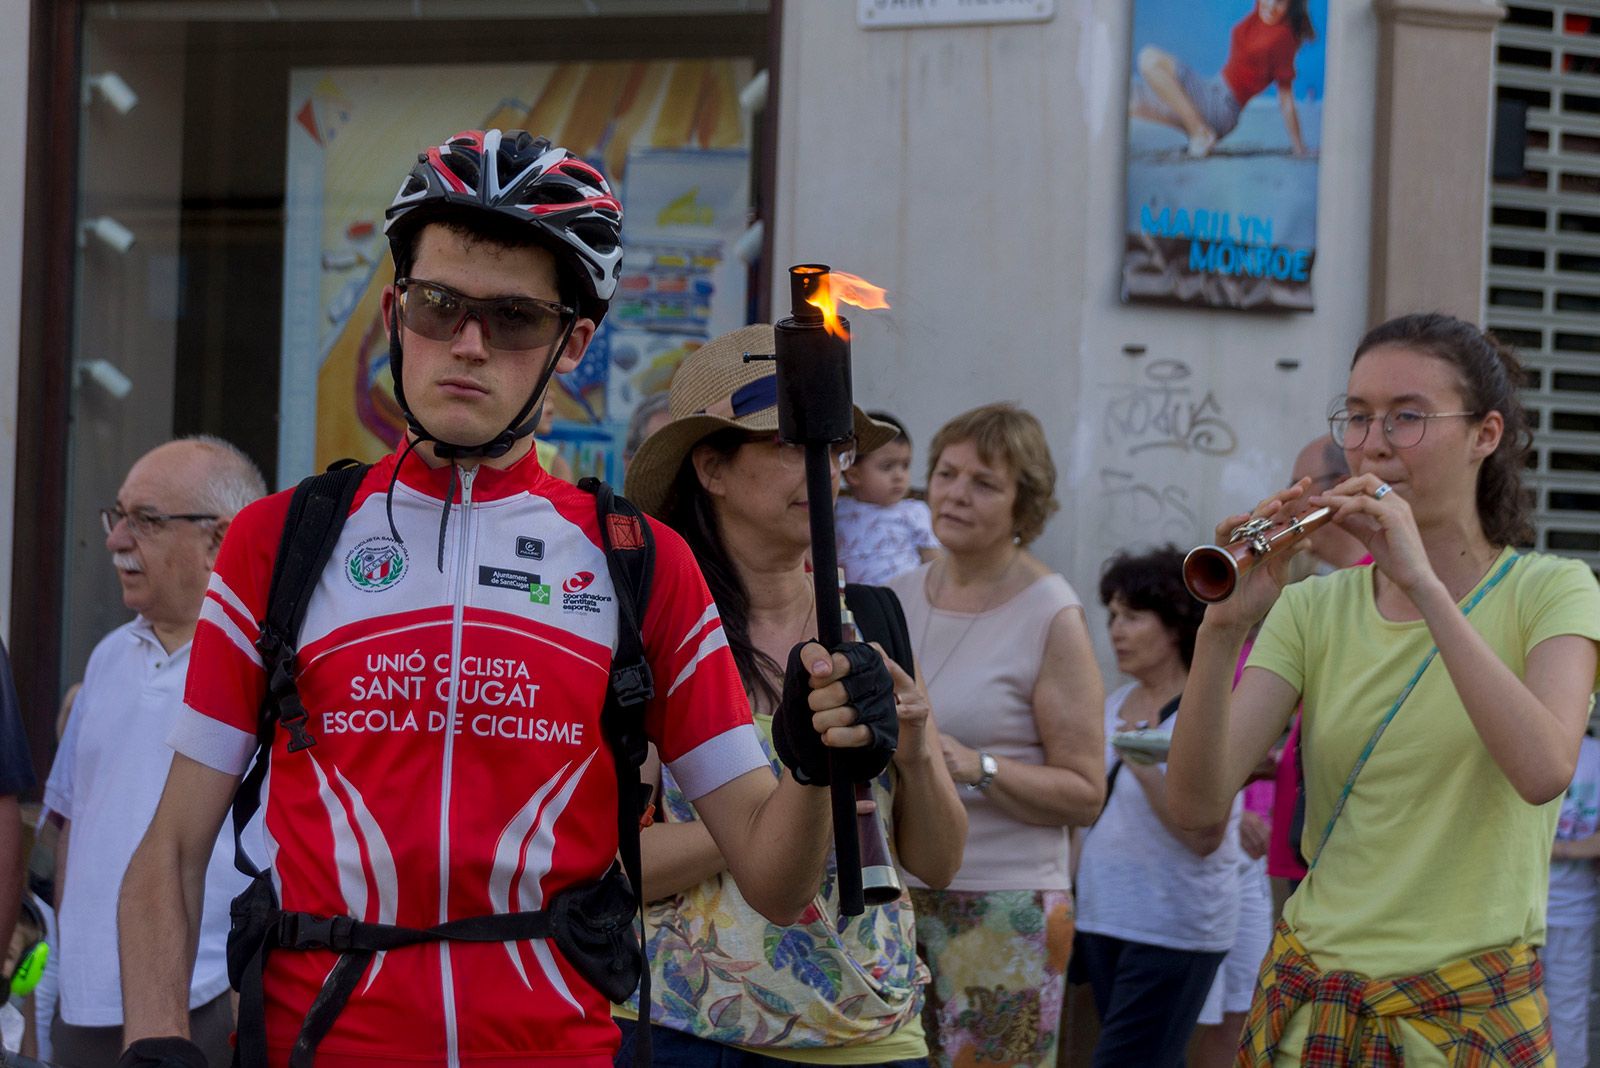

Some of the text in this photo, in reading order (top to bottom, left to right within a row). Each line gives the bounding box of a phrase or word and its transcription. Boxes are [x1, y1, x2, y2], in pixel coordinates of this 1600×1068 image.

[1140, 204, 1273, 244] MARILYN
[1189, 240, 1309, 281] MONROE
[493, 571, 528, 582] Ajuntament
[562, 605, 600, 613] esportives
[563, 593, 611, 602] coordinadora
[366, 648, 531, 680] UNIÓ CCLISTA
[350, 676, 540, 708] SANT CUGAT
[322, 709, 584, 745] ESCOLA DE CICLISME
